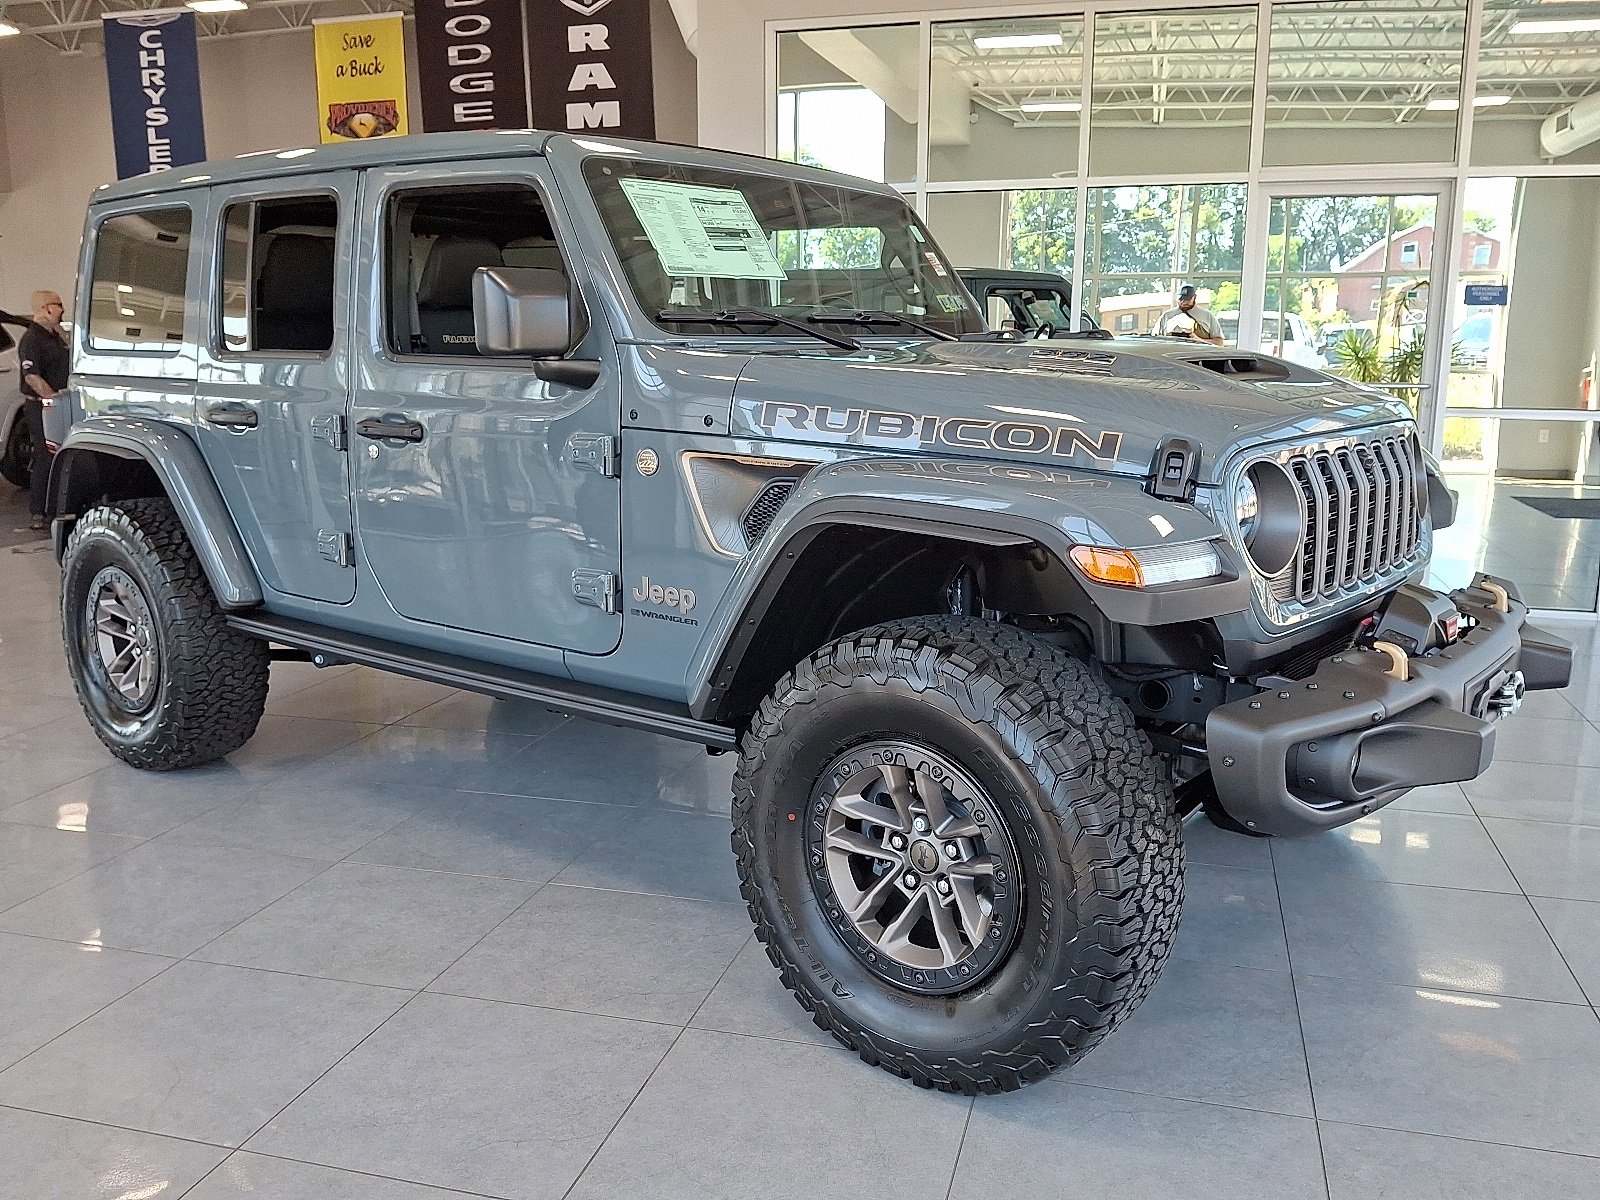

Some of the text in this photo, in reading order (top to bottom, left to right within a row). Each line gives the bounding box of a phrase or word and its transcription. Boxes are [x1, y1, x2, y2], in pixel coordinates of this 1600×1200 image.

[342, 33, 375, 51] Save
[336, 55, 385, 77] a Buck
[566, 23, 620, 129] RAM
[760, 400, 1124, 461] RUBICON
[632, 576, 697, 614] Jeep
[640, 610, 699, 627] WRANGLER
